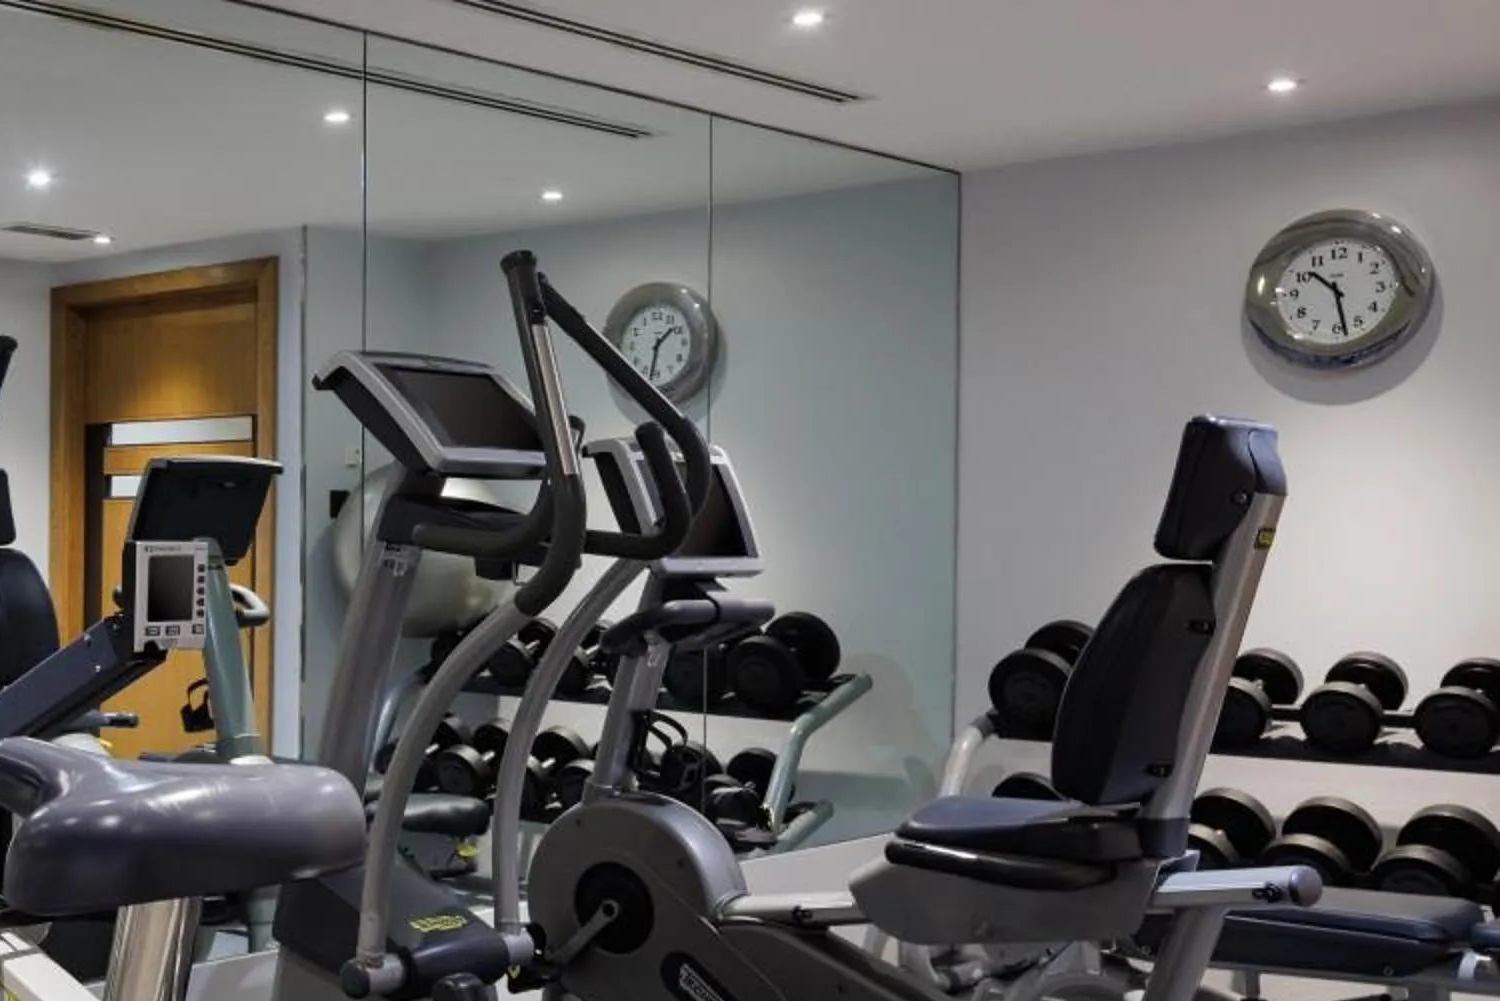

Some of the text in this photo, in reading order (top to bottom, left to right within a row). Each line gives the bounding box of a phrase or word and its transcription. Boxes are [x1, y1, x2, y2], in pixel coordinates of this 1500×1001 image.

[1330, 248, 1348, 260] 12
[1311, 255, 1324, 267] 11
[1369, 262, 1380, 274] 2
[1296, 271, 1311, 283] 10
